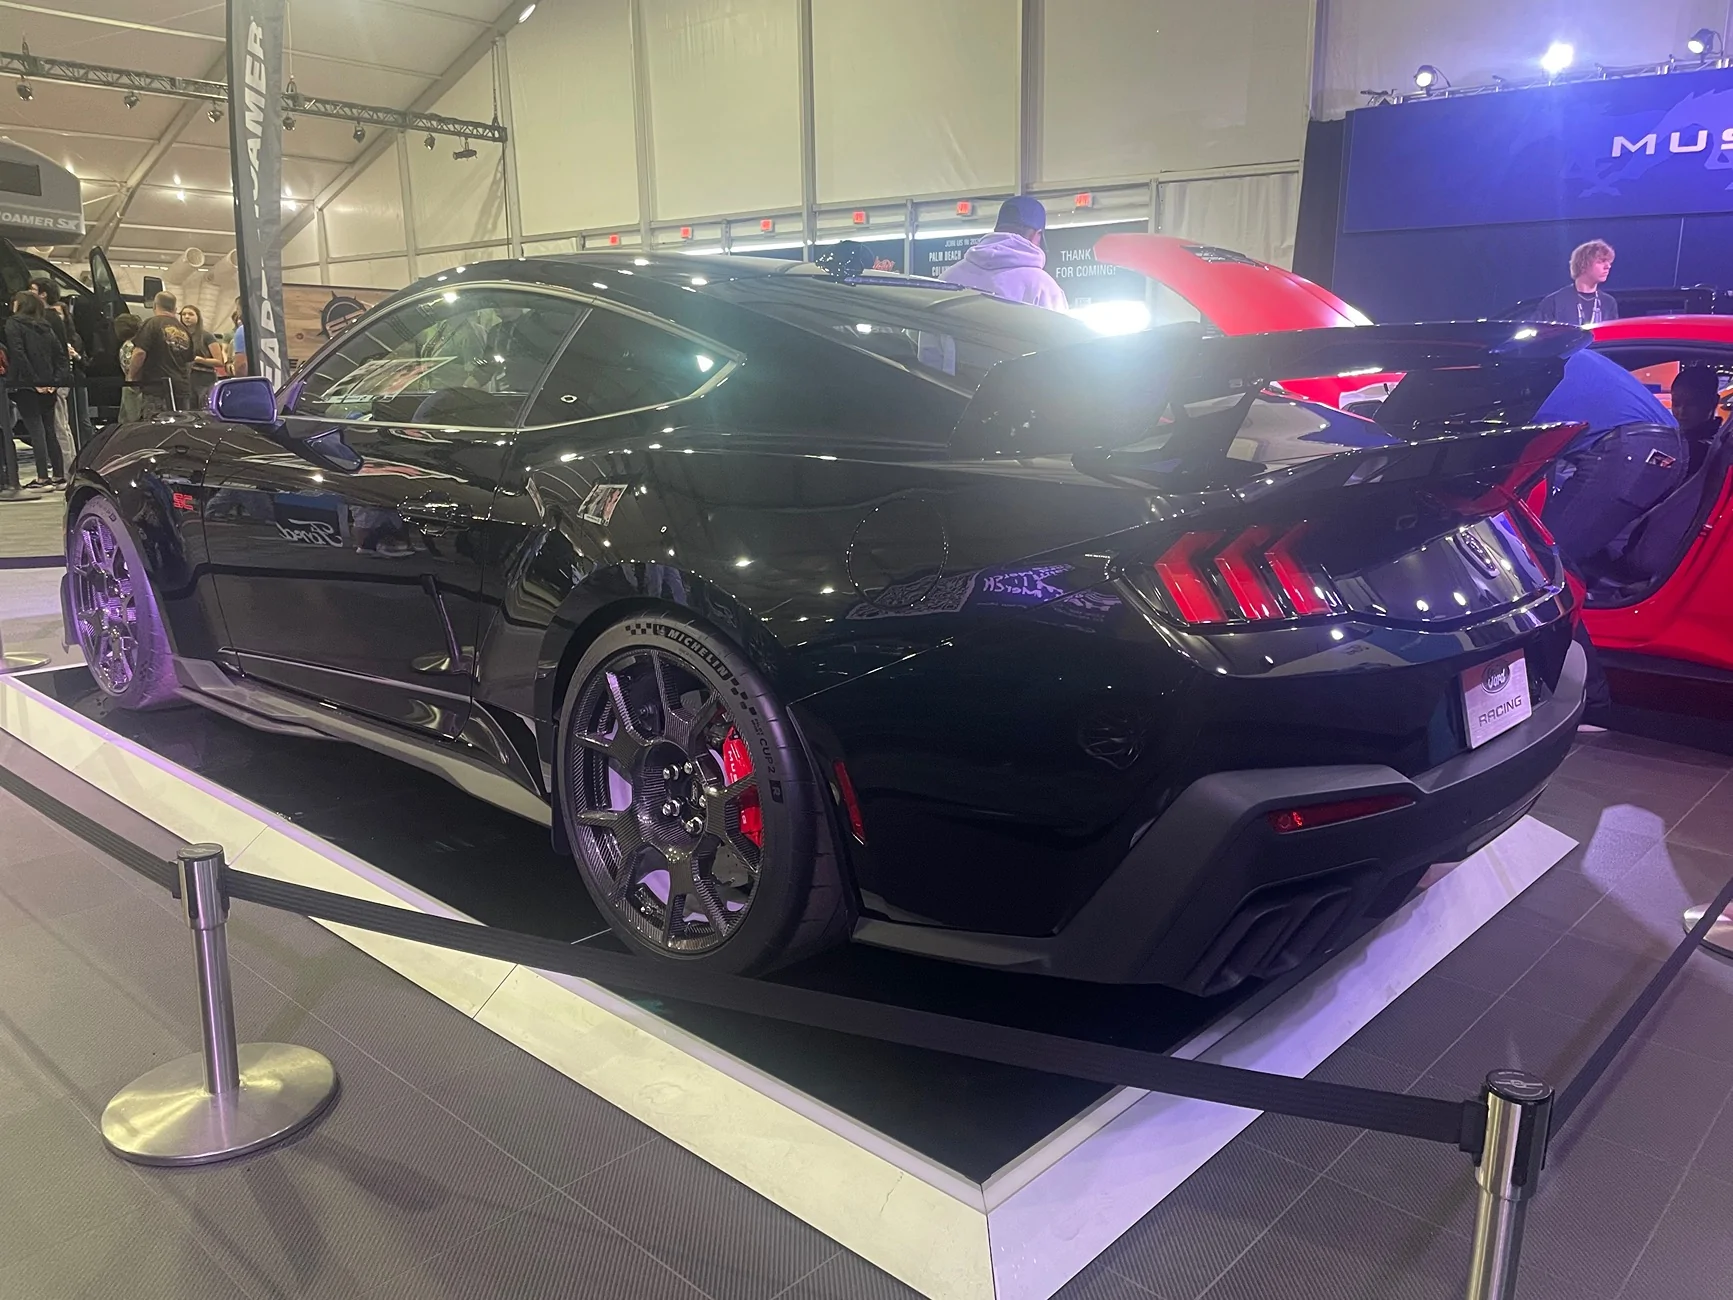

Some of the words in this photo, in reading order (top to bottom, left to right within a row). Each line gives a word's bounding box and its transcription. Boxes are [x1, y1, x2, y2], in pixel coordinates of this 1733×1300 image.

[0, 211, 54, 228] OAMER
[929, 252, 943, 262] PALM
[945, 250, 961, 261] BEACH
[1060, 249, 1091, 261] THANK
[1056, 267, 1074, 278] FOR
[1076, 265, 1116, 277] COMING!
[667, 628, 729, 678] MICHELIN
[1478, 695, 1523, 727] RACING
